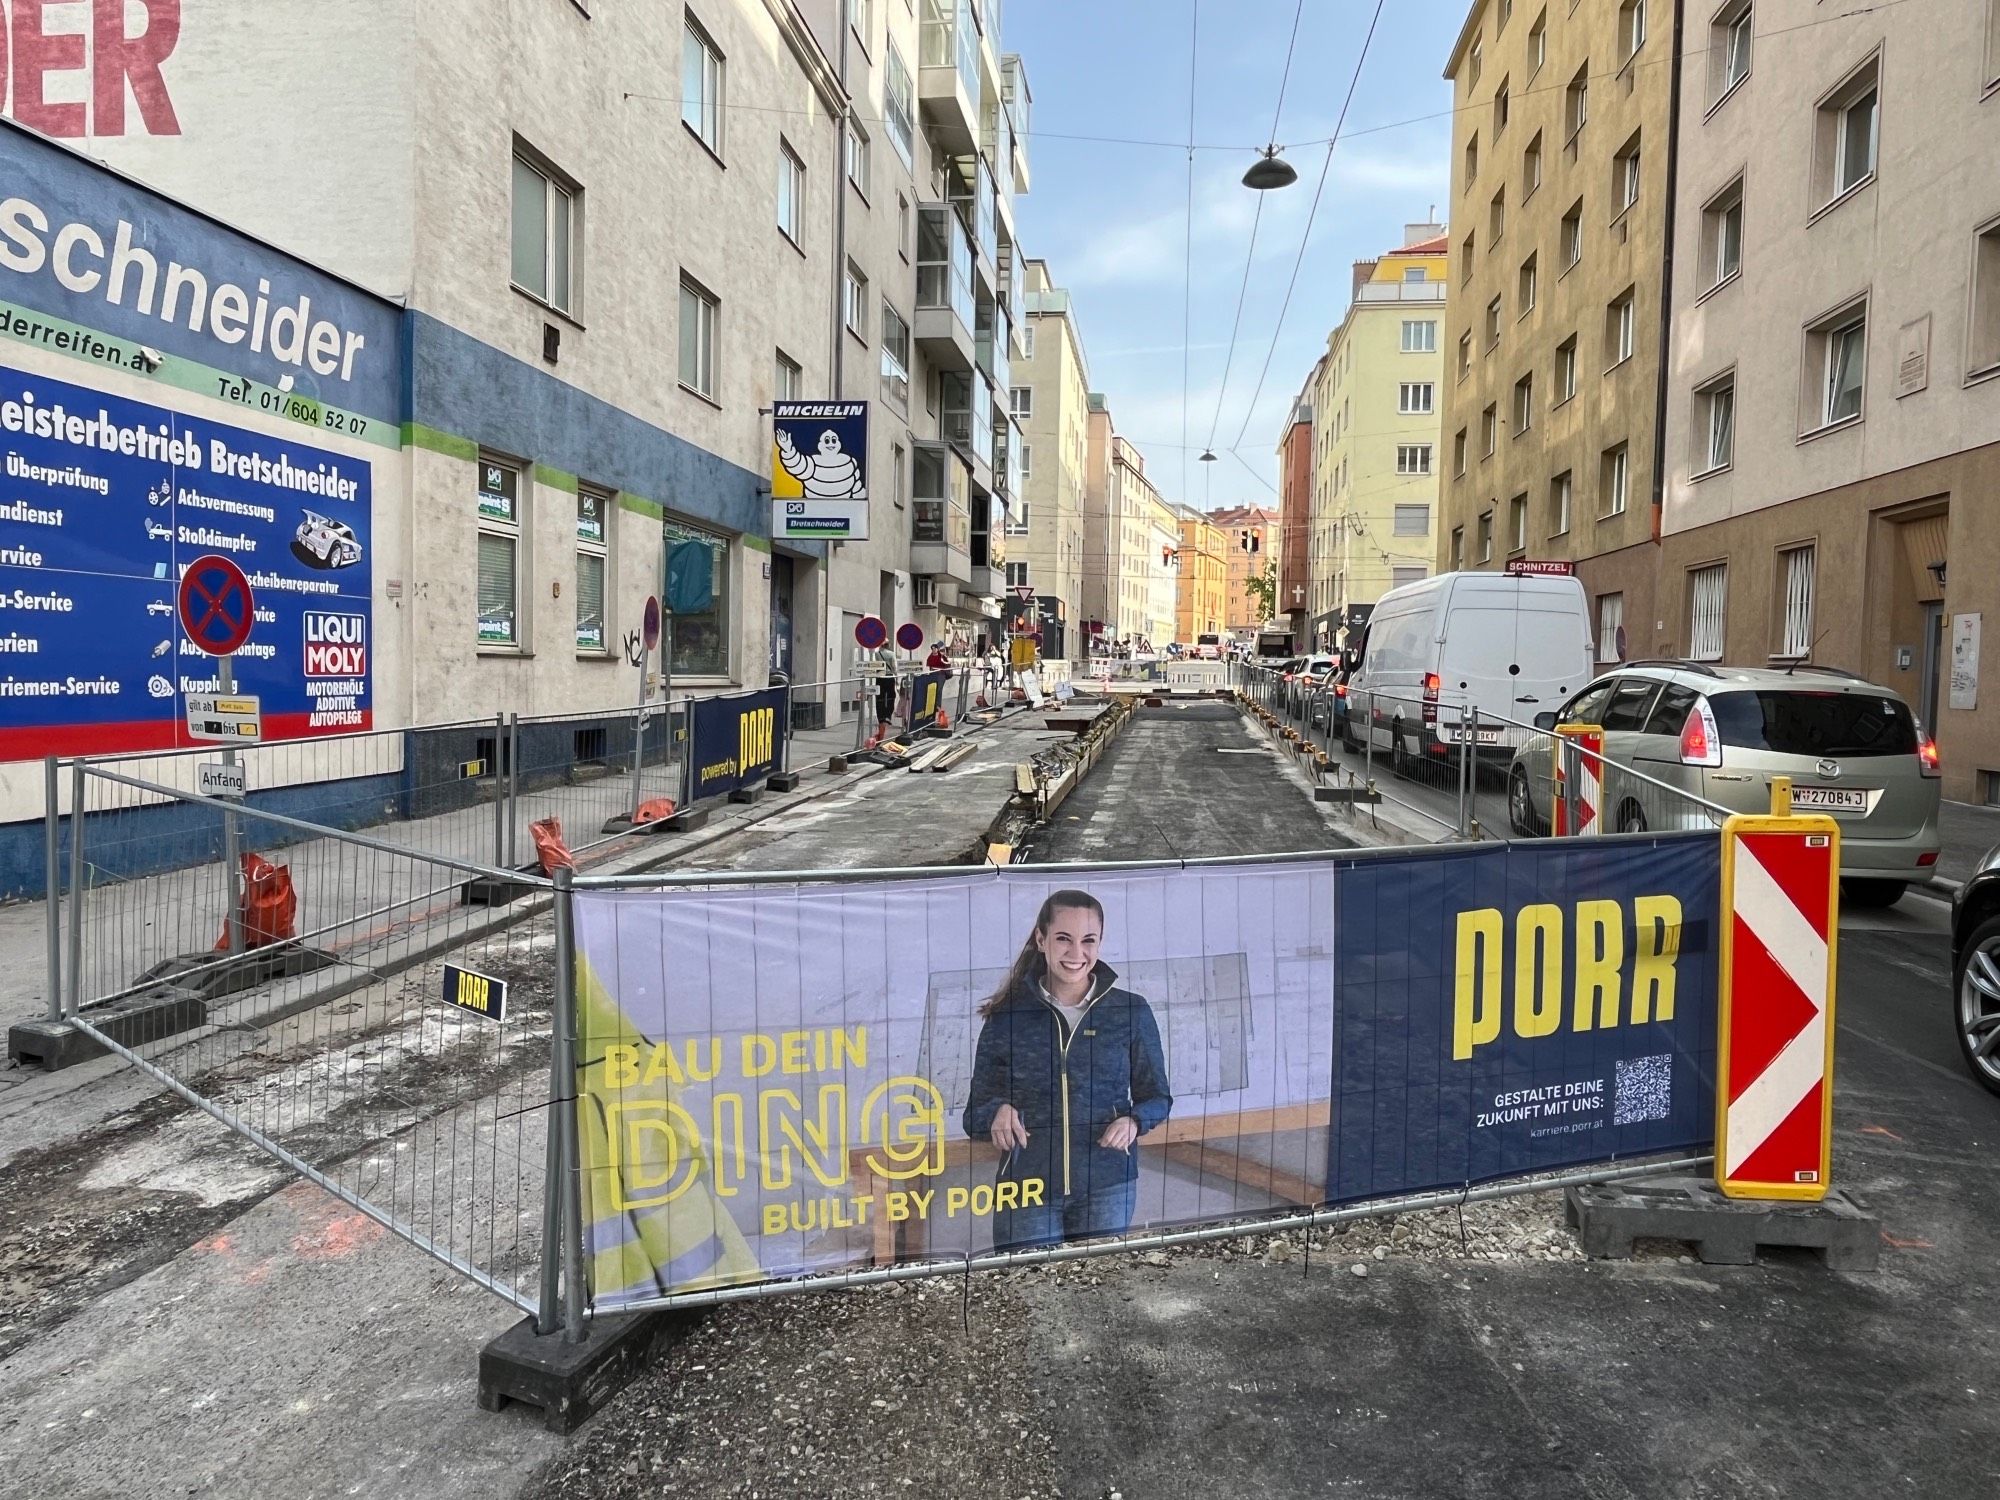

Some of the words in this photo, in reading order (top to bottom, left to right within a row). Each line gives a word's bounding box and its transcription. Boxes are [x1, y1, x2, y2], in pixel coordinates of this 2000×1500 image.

[0, 0, 182, 137] ER
[260, 391, 318, 424] 01/604
[325, 411, 344, 430] 52
[350, 418, 367, 436] 07
[777, 405, 864, 416] MICHELIN
[0, 391, 202, 470] eisterbetrieb
[210, 439, 358, 501] Bretschneider
[6, 450, 109, 496] Überprüfung
[178, 488, 275, 523] Achsvermessung
[790, 520, 845, 528] Bretschneider
[178, 525, 257, 552] Stoßdämpfer
[1509, 562, 1567, 572] SCHNITZEL
[307, 615, 362, 644] LIQUI
[308, 646, 363, 674] MOLY
[0, 675, 120, 697] riemen-Service
[306, 680, 364, 697] MOTORENÖLE
[316, 697, 356, 711] ADDITIVE
[309, 711, 362, 727] AUTOPFLEGE
[203, 772, 242, 791] Anfang
[701, 759, 729, 787] powered
[1792, 789, 1801, 802] W
[457, 970, 489, 1012] PORR
[1452, 895, 1683, 1060] PORR
[604, 1038, 722, 1089] BAU
[741, 1025, 868, 1078] DEIN
[1494, 1085, 1561, 1107] GESTALTE
[1565, 1079, 1604, 1096] DEINE
[1476, 1105, 1540, 1128] ZUKUNFT
[1544, 1100, 1569, 1116] MIT
[1572, 1096, 1604, 1112] UNS:
[1530, 1119, 1603, 1138] karriere.porr.at
[605, 1075, 945, 1212] DING
[763, 1196, 874, 1236] BUILT
[886, 1189, 935, 1222] BY
[947, 1178, 1046, 1218] PORR
